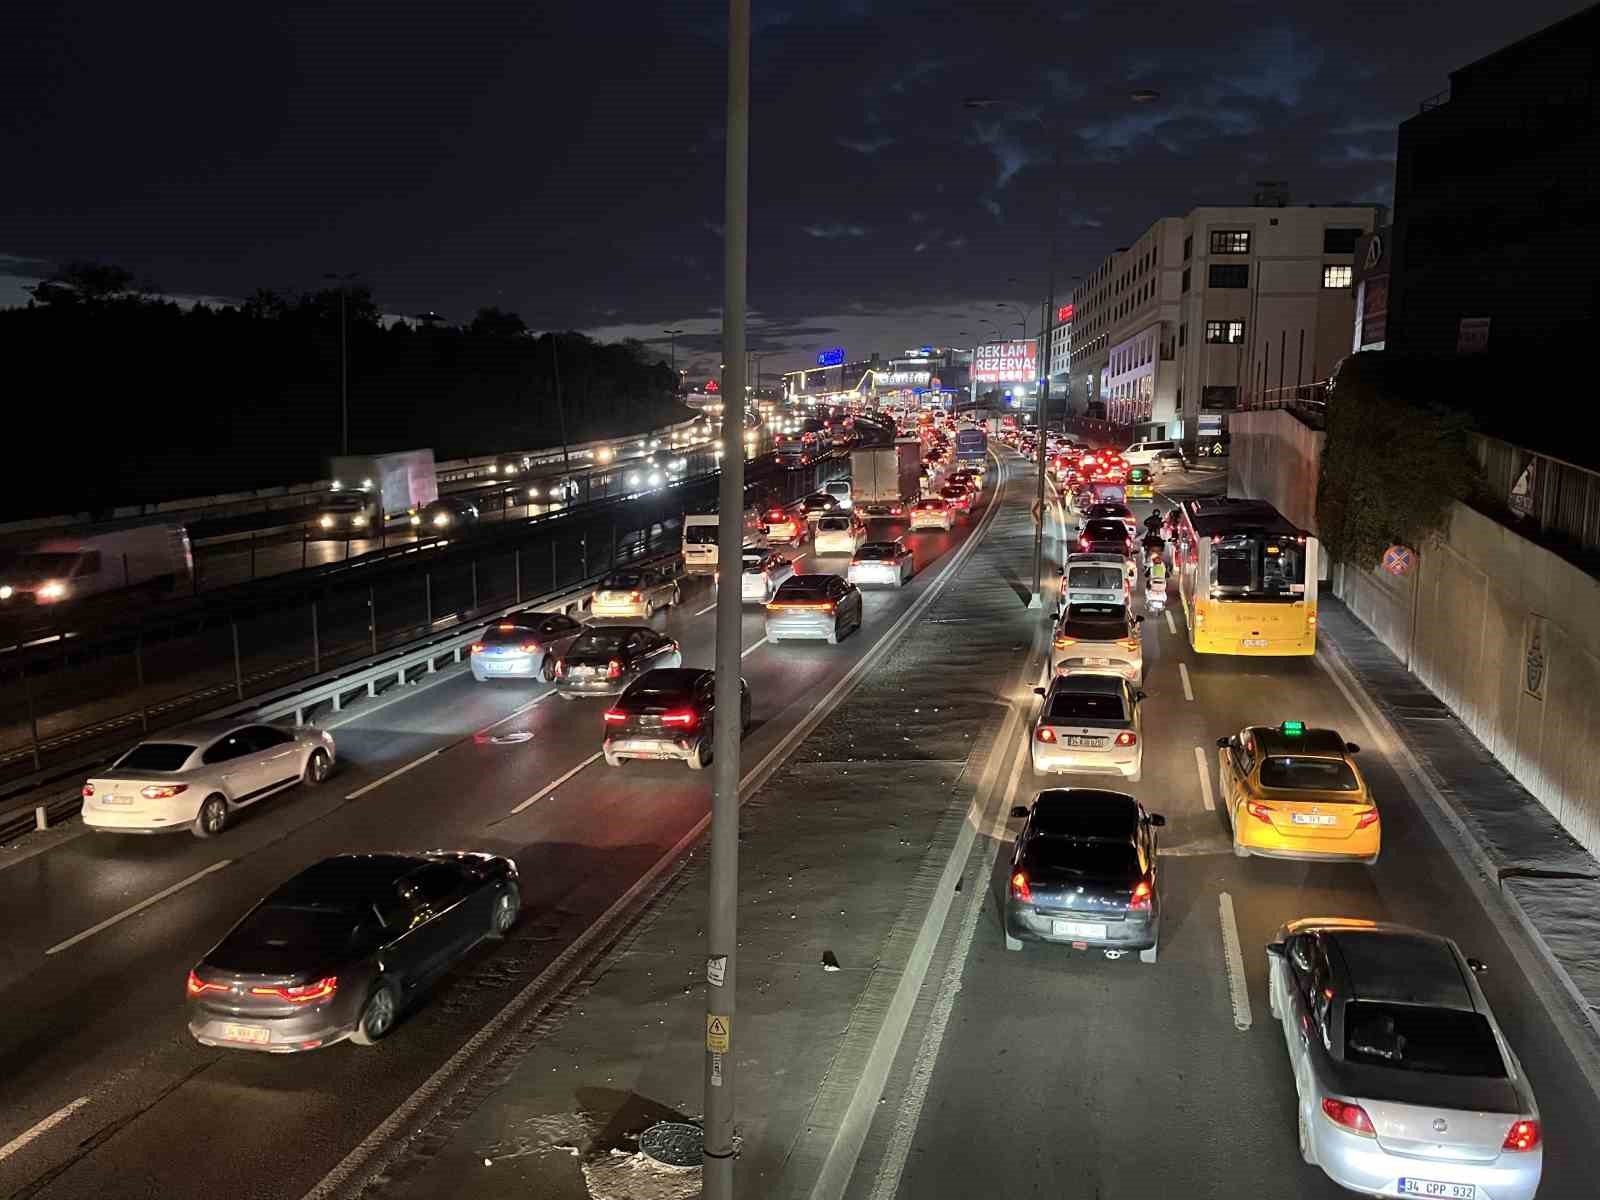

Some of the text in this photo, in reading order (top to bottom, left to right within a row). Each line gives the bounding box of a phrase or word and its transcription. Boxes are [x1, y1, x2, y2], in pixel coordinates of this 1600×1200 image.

[977, 345, 1027, 358] REKLAM
[1407, 1180, 1474, 1199] 34 CPP 932
